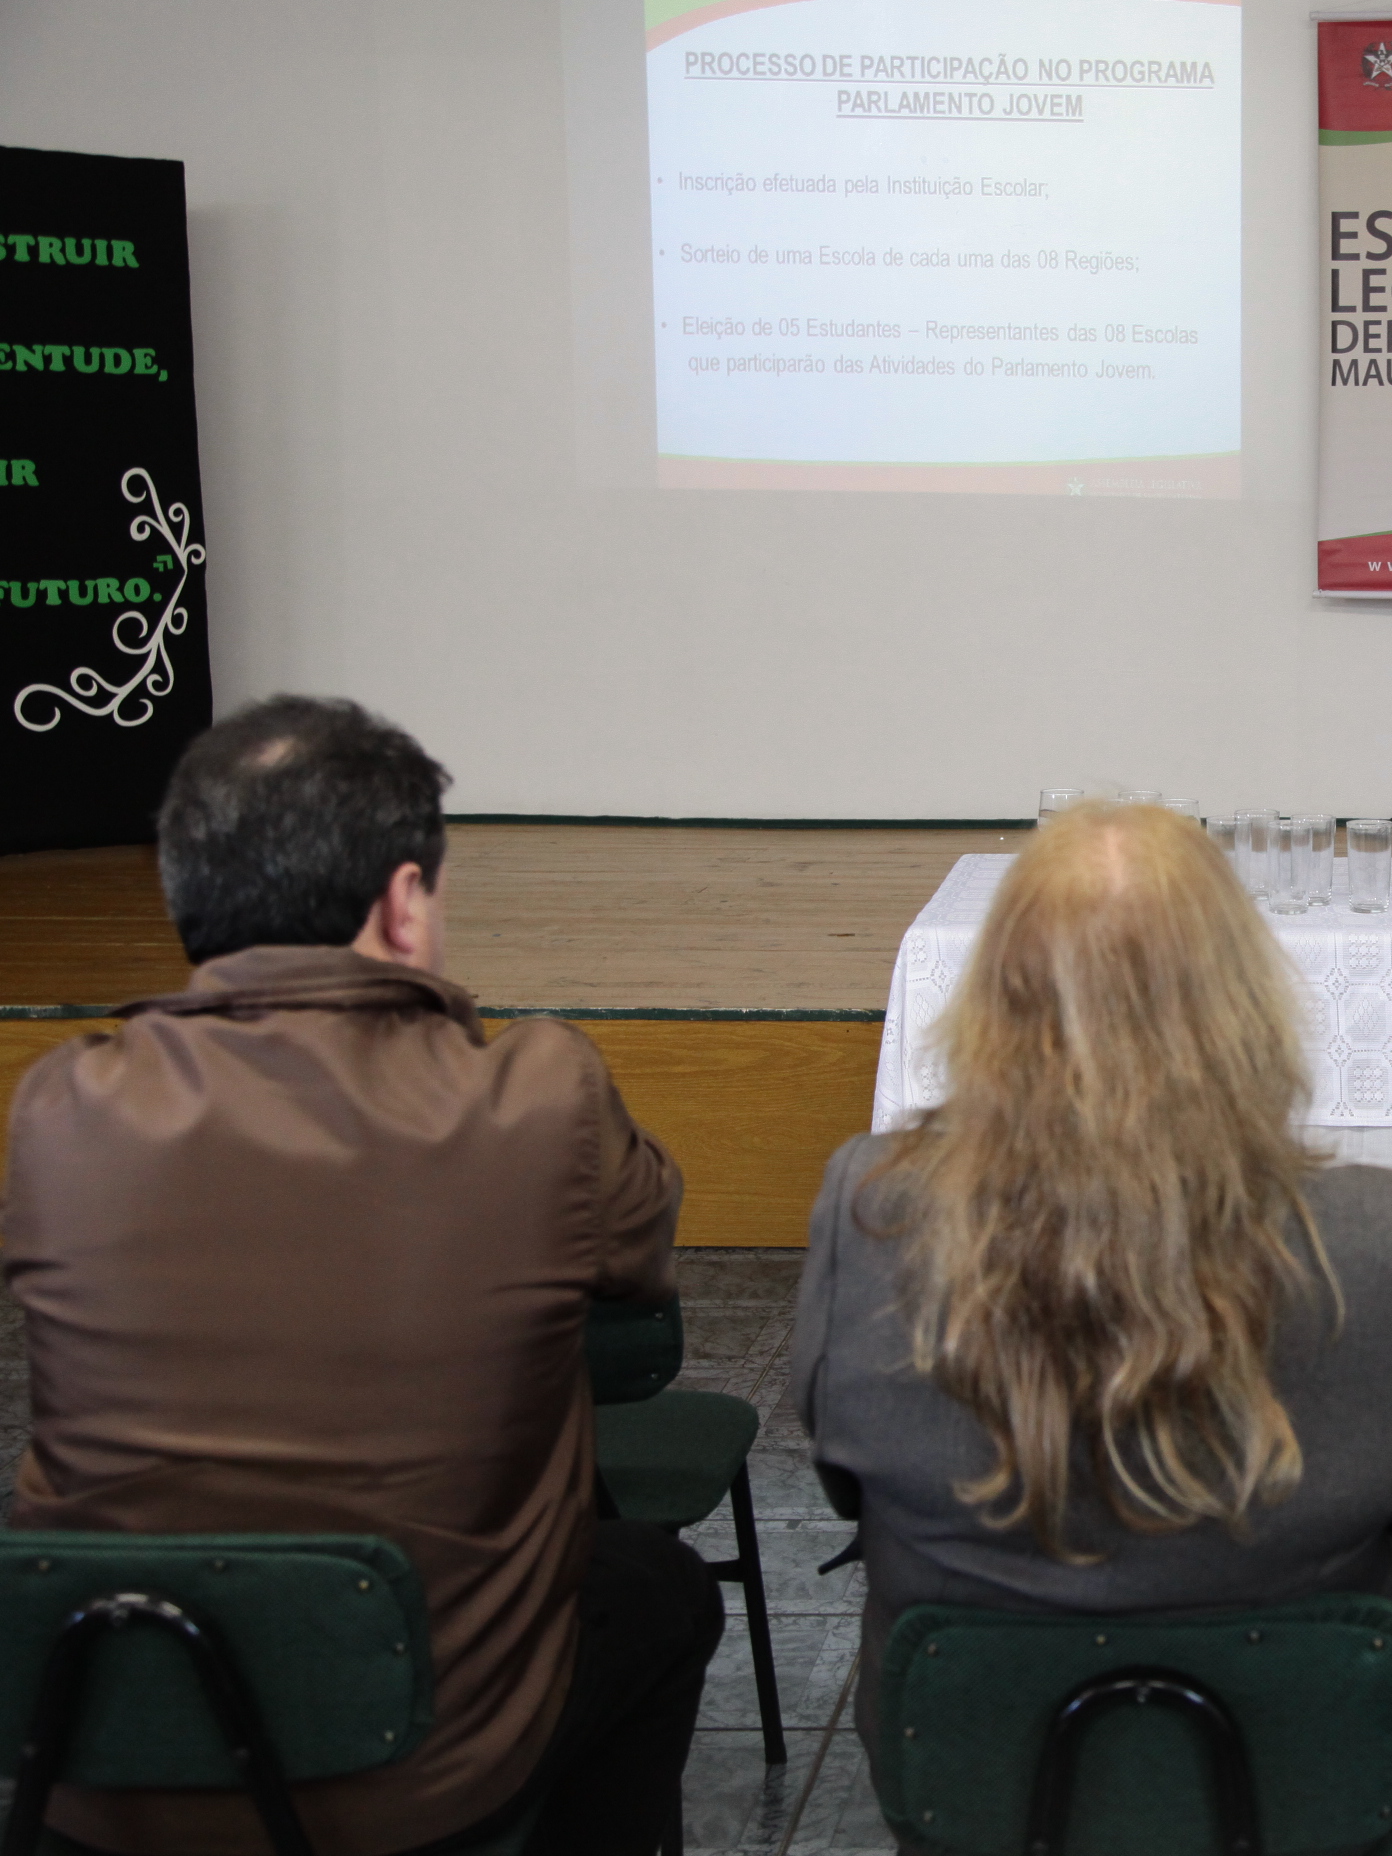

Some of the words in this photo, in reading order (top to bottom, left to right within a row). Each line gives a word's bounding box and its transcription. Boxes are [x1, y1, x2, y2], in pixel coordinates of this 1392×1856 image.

[684, 51, 816, 77] PROCESSO
[822, 54, 853, 78] DE
[860, 54, 1028, 85] PARTICIPAÇÃO
[1038, 58, 1072, 82] NO
[1079, 59, 1215, 84] PROGRAMA
[837, 90, 995, 116] PARLAMENTO
[1003, 93, 1083, 117] JOVEM
[679, 171, 757, 195] Inscrição
[763, 173, 837, 193] efetuada
[844, 175, 879, 197] pela
[887, 175, 973, 199] Instituição
[981, 177, 1049, 199] Escolar;
[681, 243, 741, 264] Sorteio
[748, 245, 769, 264] de
[776, 249, 813, 265] uma
[819, 245, 876, 266] Escola
[883, 247, 904, 266] de
[910, 248, 951, 267] cada
[957, 251, 994, 268] uma
[1001, 250, 1031, 269] das
[1037, 250, 1059, 270] 08
[1065, 250, 1139, 274] Regiões;
[682, 316, 745, 339] Eleição
[752, 317, 773, 336] de
[779, 318, 800, 337] 05
[807, 318, 901, 338] Estudantes
[925, 320, 1059, 343] Representantes
[1067, 323, 1097, 342] das
[1105, 323, 1126, 343] 08
[1132, 324, 1198, 345] Escolas
[688, 356, 720, 375] que
[726, 353, 825, 377] participarão
[834, 354, 864, 374] das
[869, 354, 955, 375] Atividades
[964, 357, 985, 376] do
[992, 357, 1088, 378] Parlamento
[1096, 359, 1156, 380] Jovem.
